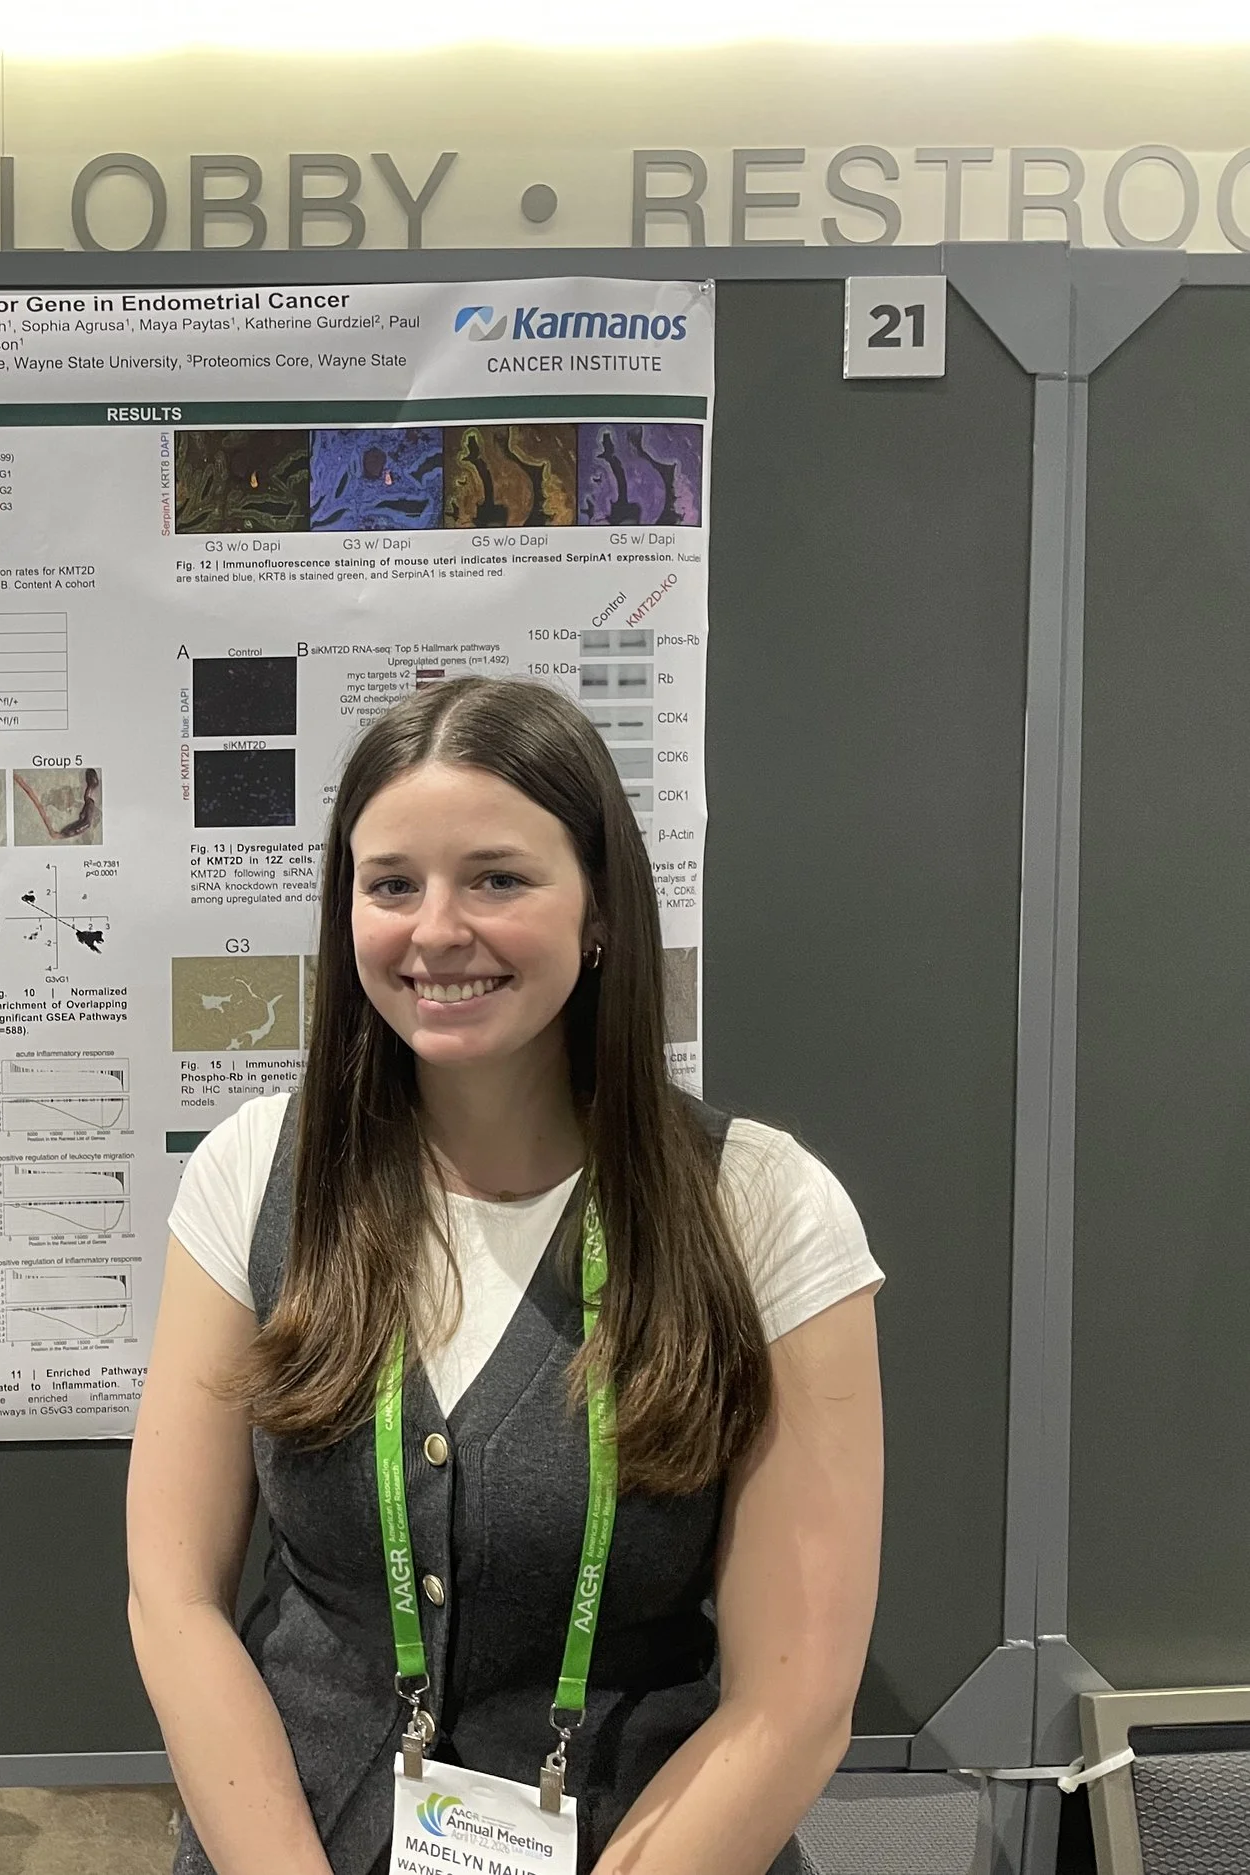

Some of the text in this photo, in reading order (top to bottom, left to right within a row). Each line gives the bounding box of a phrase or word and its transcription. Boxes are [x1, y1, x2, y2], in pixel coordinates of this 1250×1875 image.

[0, 152, 458, 251] LOBBY
[26, 296, 85, 312] Gene
[93, 295, 113, 311] in
[122, 293, 259, 311] Endometrial
[268, 292, 349, 309] Cancer
[21, 319, 70, 335] Sophia
[139, 318, 177, 333] Maya
[245, 316, 311, 329] Katherine
[389, 315, 419, 328] Paul
[512, 306, 687, 340] Karmanos
[867, 303, 924, 348] 21
[13, 356, 63, 372] Wayne
[67, 355, 104, 369] State
[109, 355, 181, 371] University,
[275, 353, 312, 368] Core,
[317, 353, 366, 369] Wayne
[370, 353, 406, 366] State
[487, 354, 661, 373] CANCER INSTITUTE
[107, 407, 181, 421] RESULTS
[205, 539, 280, 554] G3 w/o Dapi
[342, 537, 410, 551] G3 w/ Dapi
[625, 573, 678, 628] KMT2D-KO
[591, 591, 627, 628] Control
[528, 629, 549, 640] 150
[657, 634, 700, 648] phos-Rb
[657, 672, 674, 684] Rb
[657, 711, 688, 723] CDK4
[31, 754, 83, 769] Group 5
[657, 750, 688, 762] CDK6
[657, 789, 688, 801] CDK1
[658, 828, 694, 843] β-Actin
[24, 988, 35, 997] 10
[70, 986, 127, 996] Normalized
[51, 1000, 61, 1009] of
[66, 999, 127, 1010] Overlapping
[45, 1012, 75, 1021] GSEA
[79, 1012, 127, 1022] Pathways
[382, 1458, 396, 1543] American Association
[396, 1502, 405, 1530] Cancer
[398, 1531, 407, 1543] for
[390, 1547, 415, 1614] AACR
[574, 1563, 601, 1633] AACR
[446, 1815, 493, 1838] Annual
[497, 1828, 553, 1857] Meeting
[405, 1836, 483, 1872] MADELYN
[488, 1860, 536, 1875] MAU
